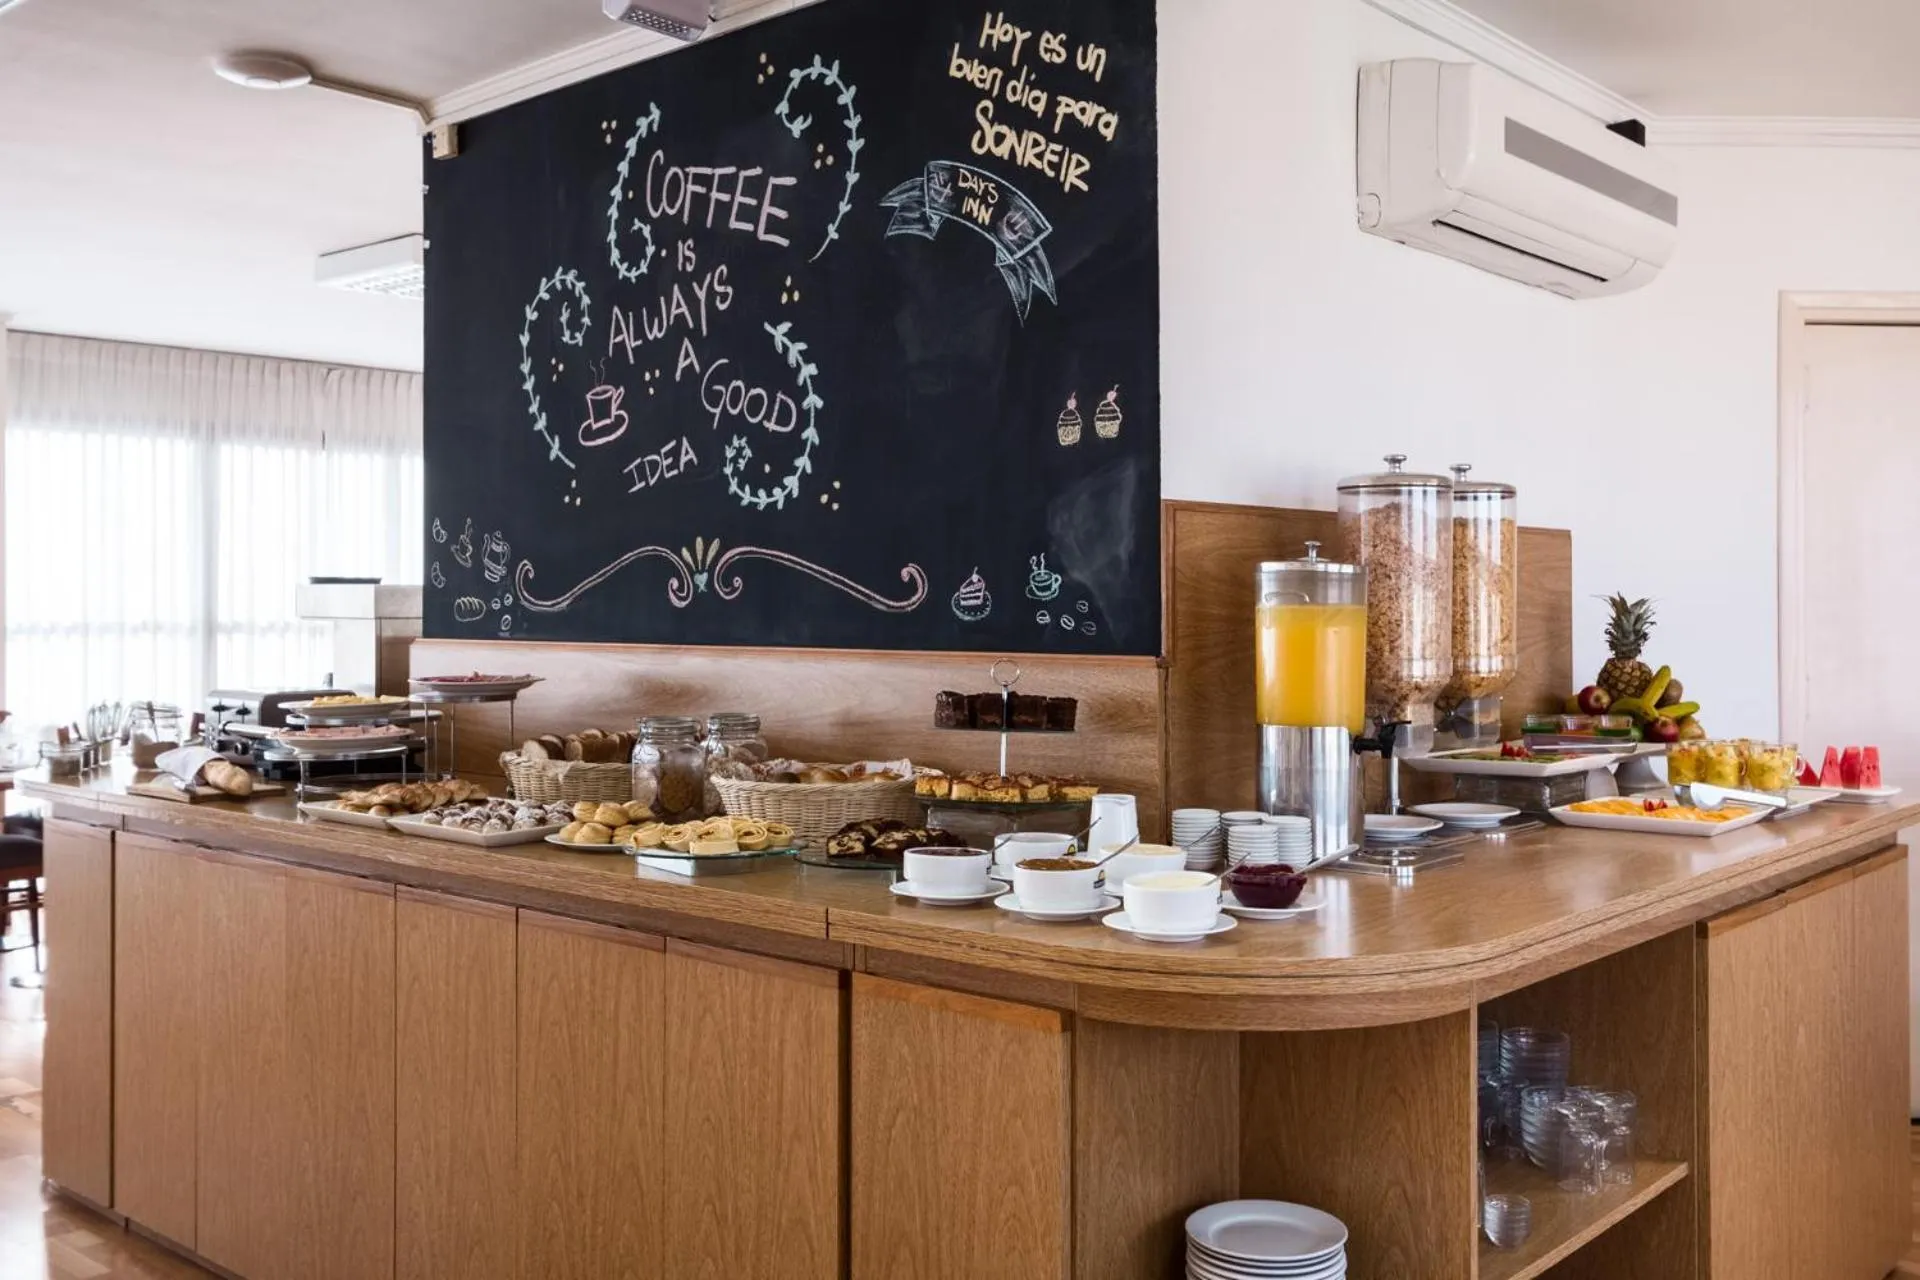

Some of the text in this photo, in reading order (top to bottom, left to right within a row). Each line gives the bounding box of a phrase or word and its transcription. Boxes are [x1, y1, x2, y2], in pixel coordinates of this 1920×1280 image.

[979, 11, 1106, 83] Hoy es un
[949, 42, 1003, 98] buen
[1053, 95, 1119, 142] para
[970, 99, 1091, 193] SONREIR
[645, 150, 798, 248] COFFEE
[958, 168, 999, 204] DAYS
[961, 196, 994, 226] INN
[677, 239, 697, 273] IS
[608, 264, 734, 365] ALWAYS
[675, 337, 701, 382] A
[701, 358, 797, 432] GOOD
[623, 436, 699, 493] IDEA
